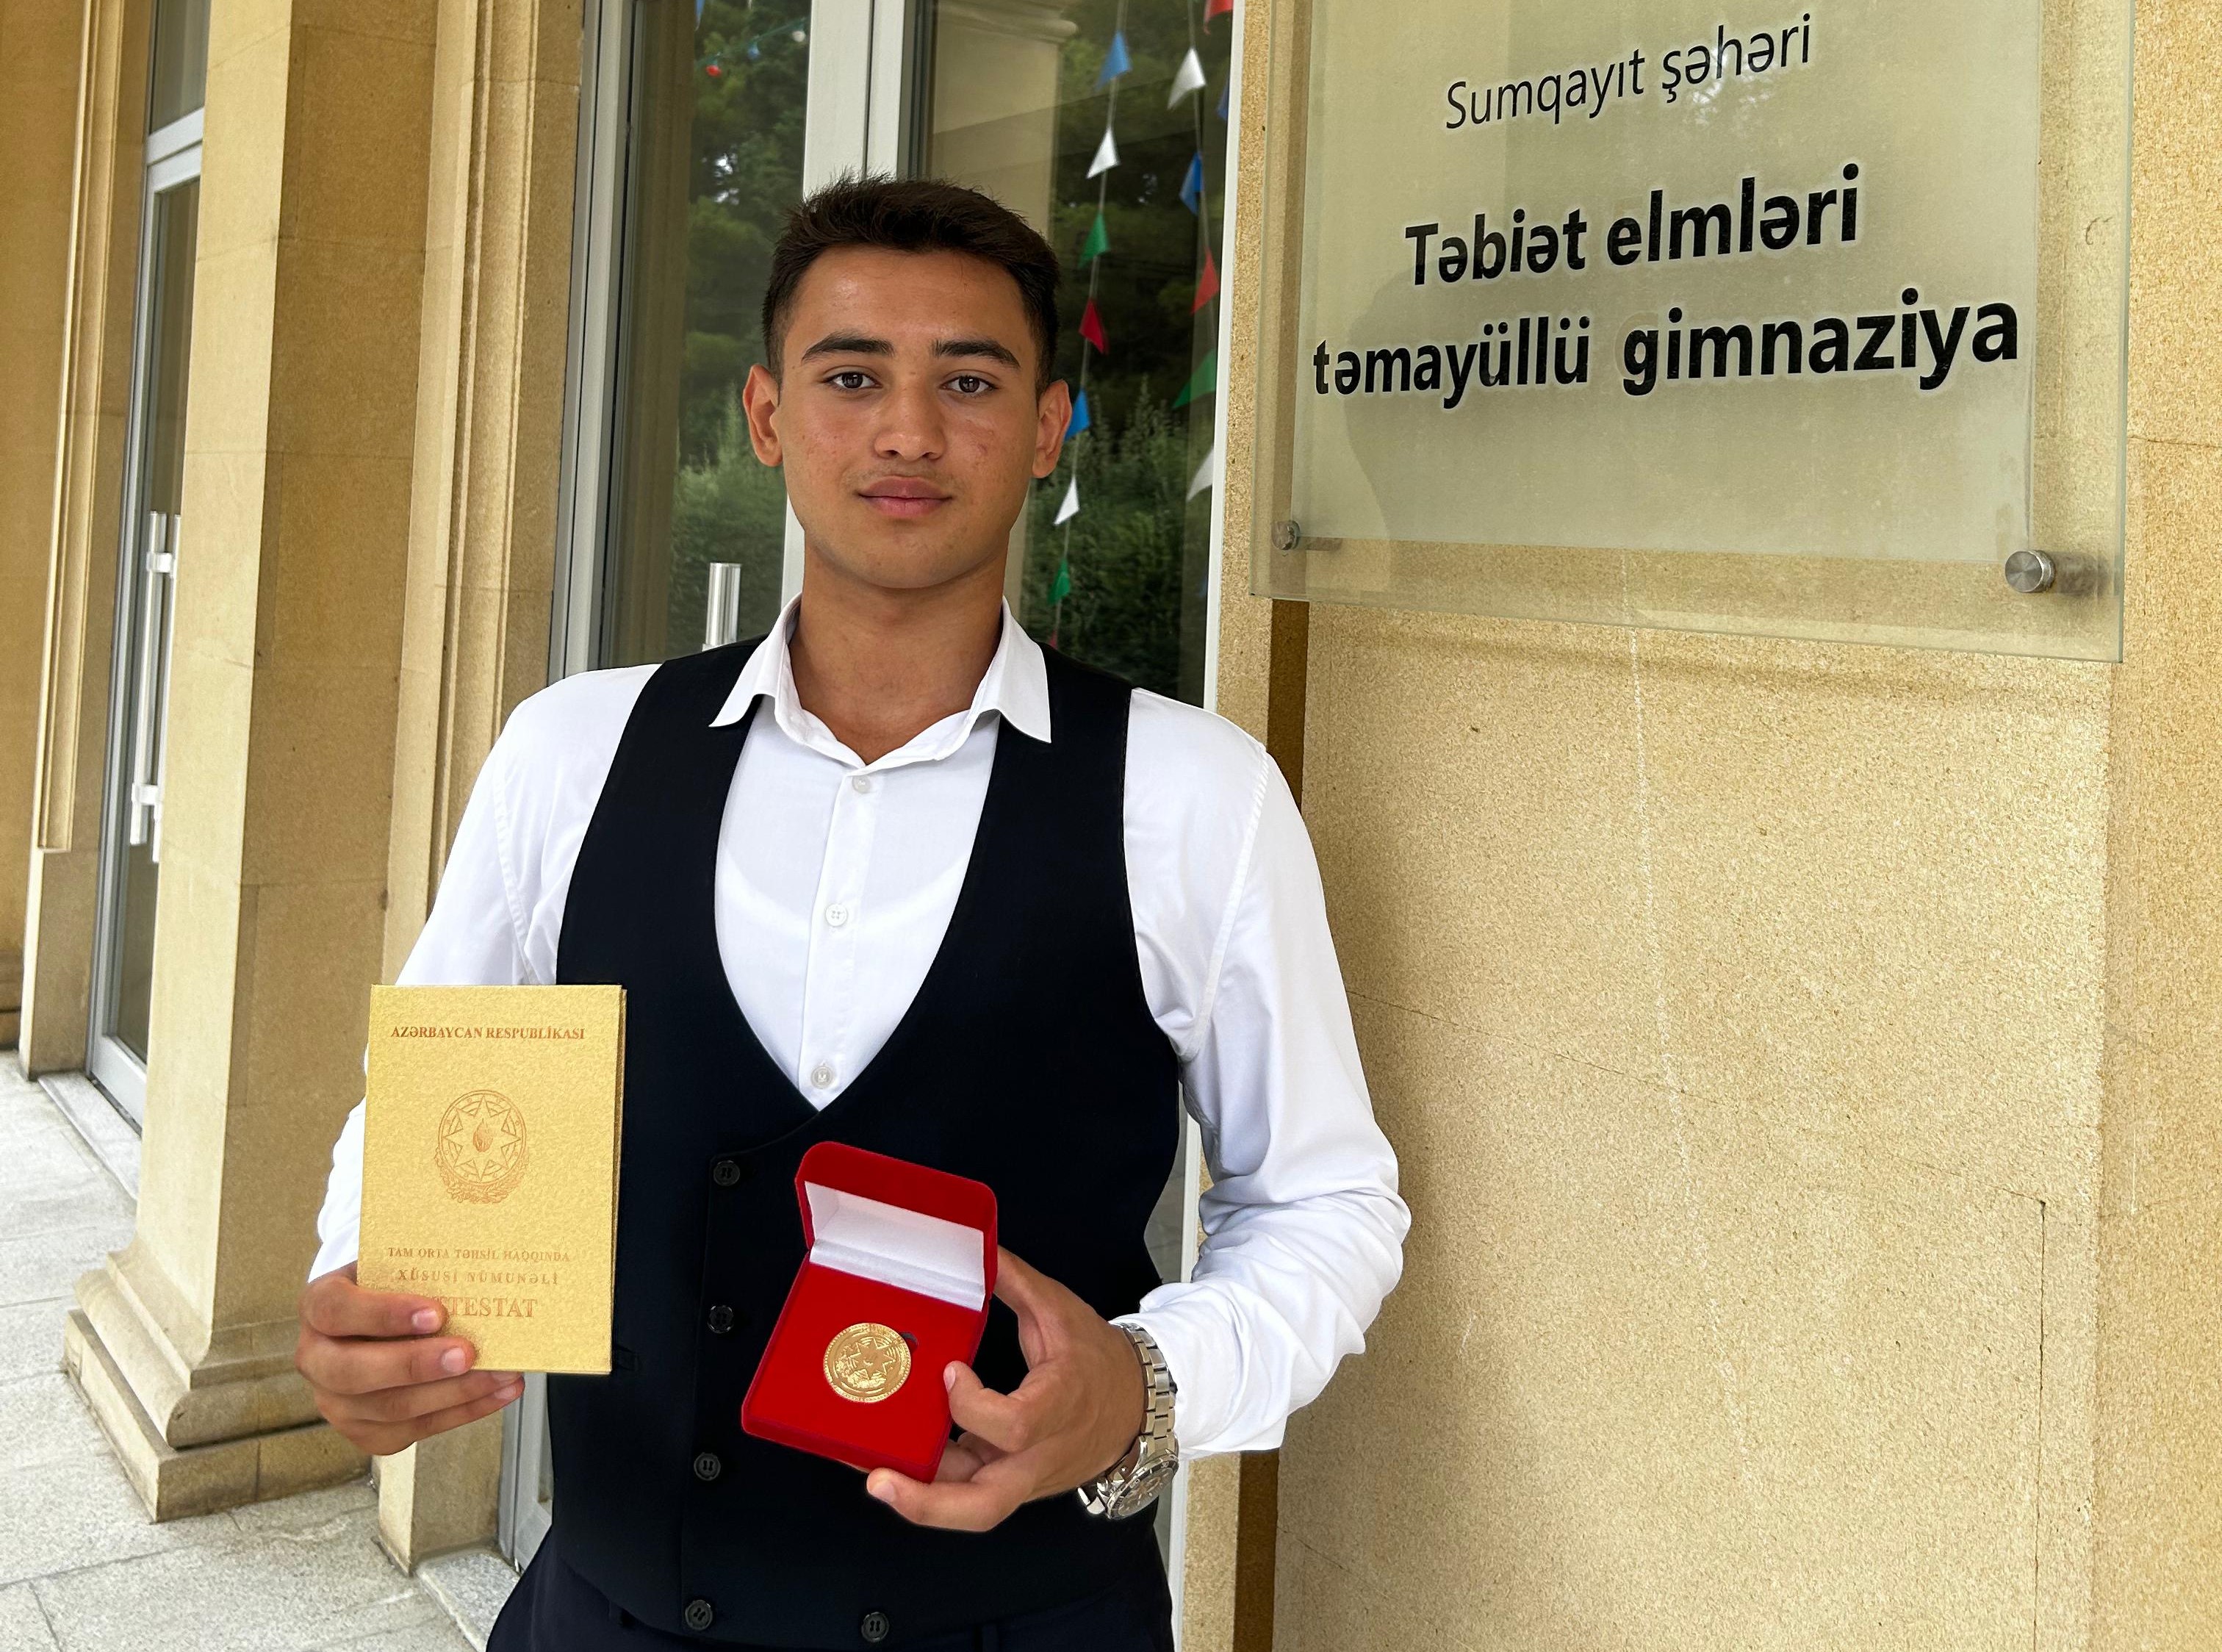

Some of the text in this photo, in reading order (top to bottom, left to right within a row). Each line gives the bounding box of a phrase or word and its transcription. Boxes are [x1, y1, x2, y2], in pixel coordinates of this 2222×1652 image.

[1445, 13, 1812, 130] Sumqayıt şəhəri
[1404, 163, 1859, 287] Təbiət elmləri
[1313, 287, 2018, 409] təmayüllü gimnaziya
[391, 1026, 586, 1040] AZƏRBAYCAN RESPUBLİKASI
[388, 1247, 413, 1258] TAM
[418, 1249, 450, 1259] ORTA
[503, 1249, 571, 1263] HAQQINDA
